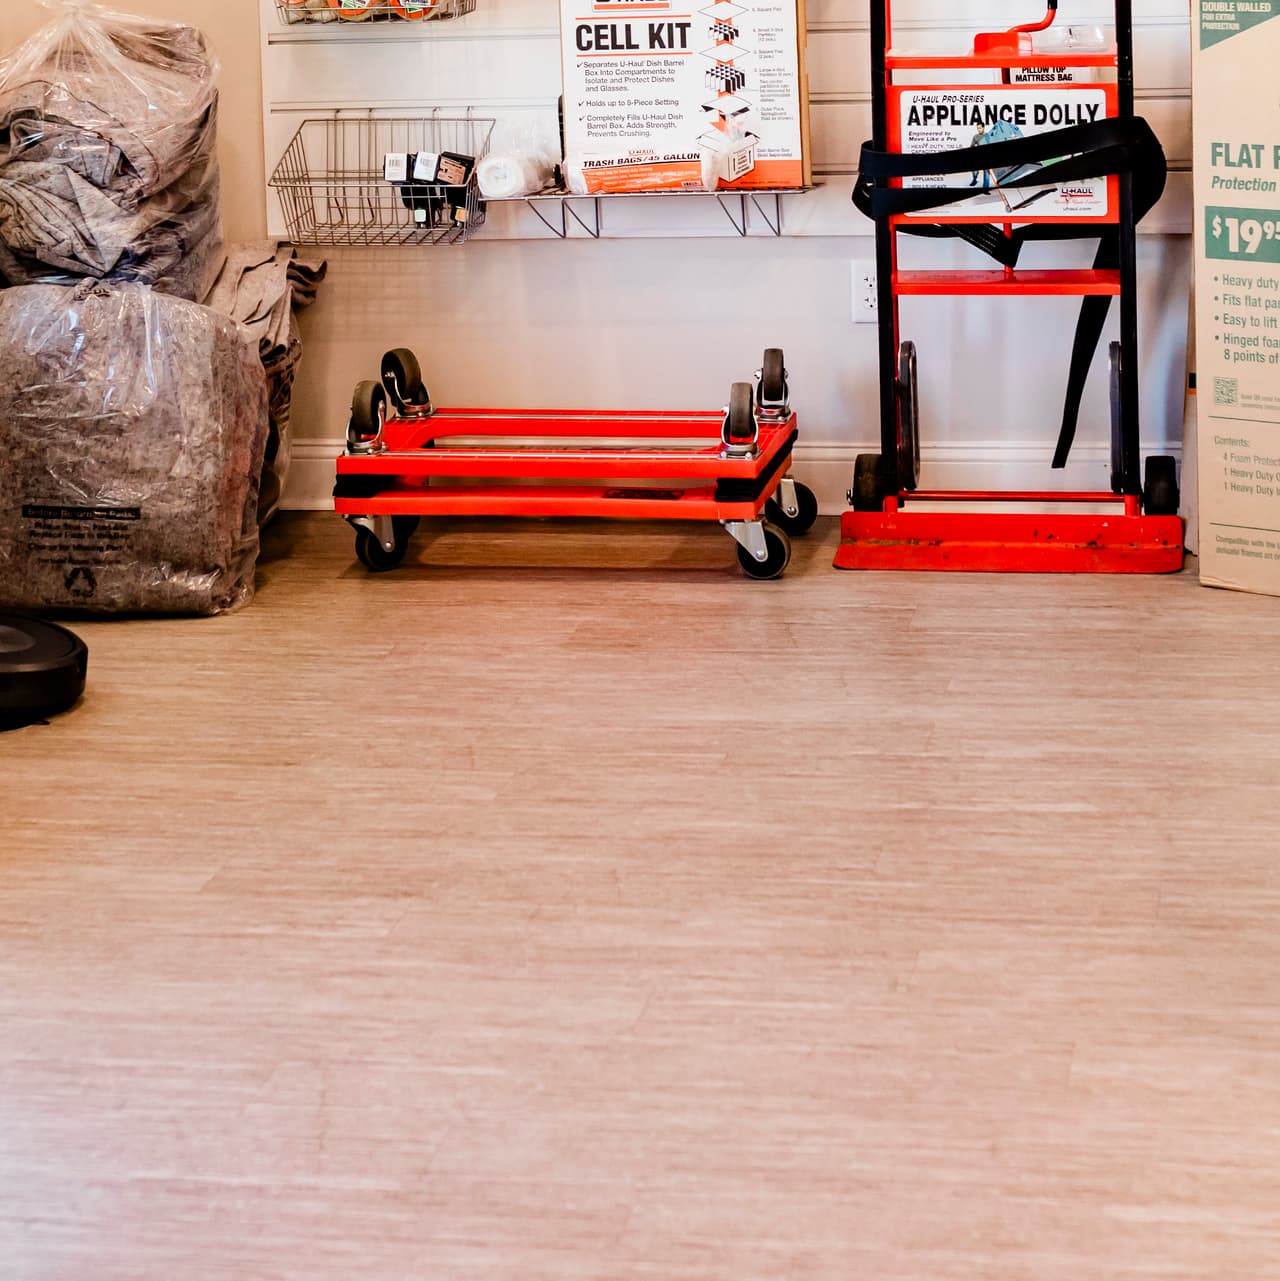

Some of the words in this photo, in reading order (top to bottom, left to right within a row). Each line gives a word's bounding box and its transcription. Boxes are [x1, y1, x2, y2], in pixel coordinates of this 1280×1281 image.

[1202, 2, 1235, 11] DOUBLE
[1236, 2, 1271, 12] WALLED
[576, 23, 640, 51] CELL
[648, 22, 691, 49] KIT
[615, 68, 666, 76] Compartments
[1015, 74, 1055, 82] MATTRESS
[1058, 73, 1072, 81] BAG
[654, 99, 680, 107] Setting
[913, 95, 939, 103] U-HAUL
[942, 95, 985, 103] PRO-SERIES
[907, 104, 1025, 126] APPLIANCE
[1034, 103, 1099, 125] DOLLY
[1211, 142, 1264, 168] FLAT
[1211, 175, 1277, 193] Protection
[1222, 274, 1252, 289] Heavy
[1257, 276, 1279, 291] duty
[1222, 294, 1241, 305] Fits
[1245, 295, 1261, 307] flat
[1223, 313, 1246, 328] Easy
[1250, 316, 1260, 327] to
[1264, 316, 1278, 328] lift
[1223, 333, 1259, 348] Hinged
[1224, 348, 1230, 360] 8
[1233, 351, 1265, 363] points
[1268, 353, 1278, 364] of
[1214, 435, 1250, 448] Contents:
[1230, 453, 1251, 464] Foam
[1230, 468, 1253, 479] Heavy
[1256, 470, 1273, 482] Duty
[1230, 483, 1253, 494] Heavy
[1256, 484, 1274, 496] Duty
